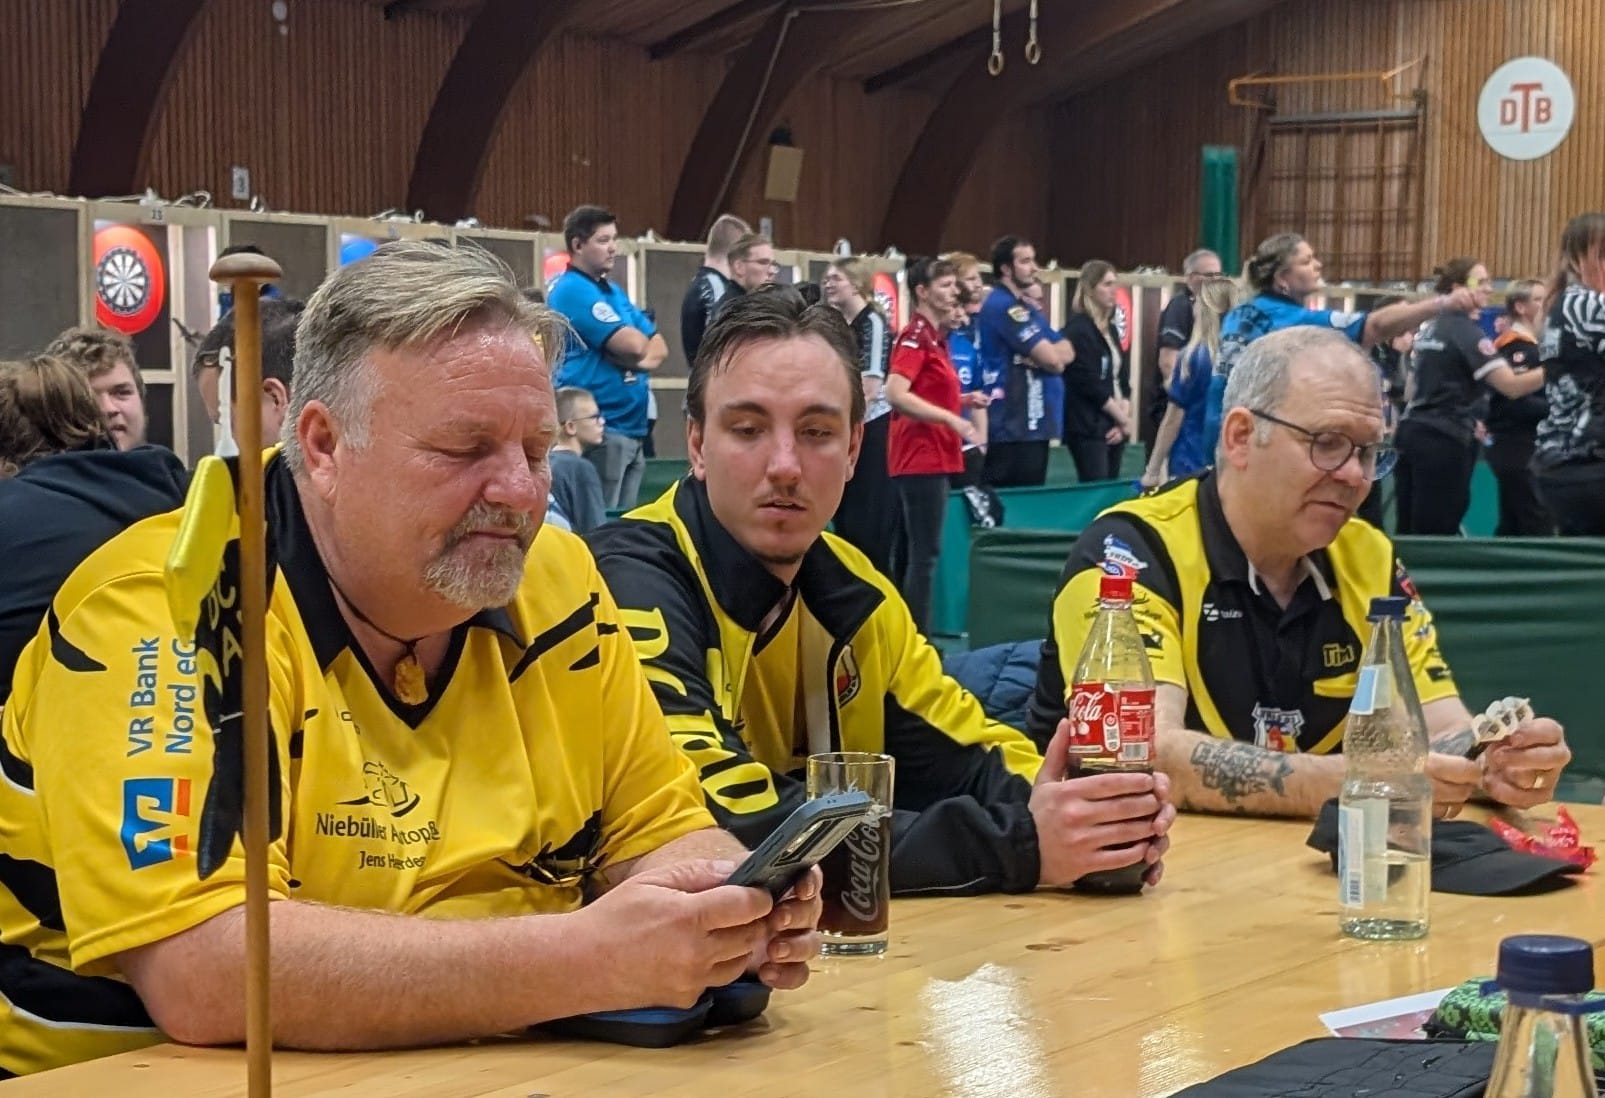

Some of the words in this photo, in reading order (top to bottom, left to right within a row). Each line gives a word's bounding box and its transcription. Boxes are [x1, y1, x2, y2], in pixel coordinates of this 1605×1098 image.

[1500, 83, 1552, 133] DTB
[130, 636, 161, 707] Bank
[126, 715, 155, 758] VR
[164, 684, 197, 754] Nord
[359, 850, 386, 869] Jens
